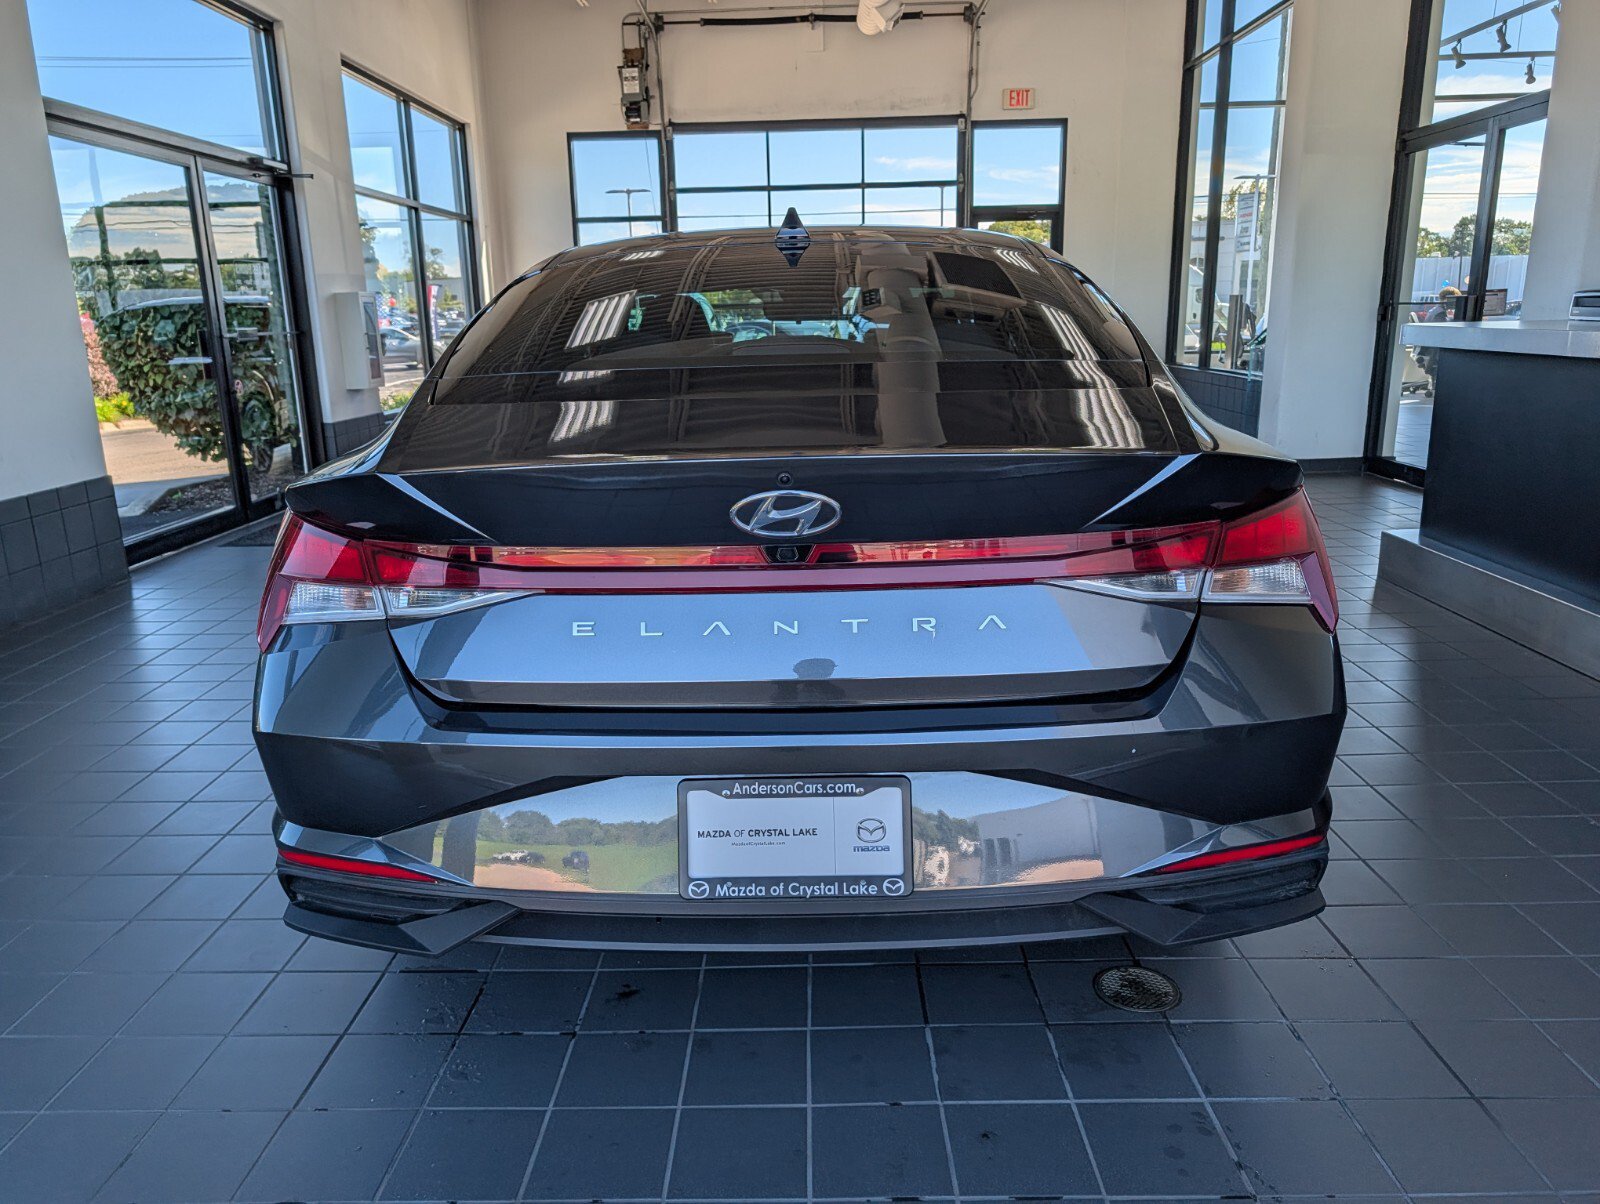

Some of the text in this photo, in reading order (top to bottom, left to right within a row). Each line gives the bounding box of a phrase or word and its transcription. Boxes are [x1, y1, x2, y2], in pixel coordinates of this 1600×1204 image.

[1009, 89, 1030, 107] EXIT
[572, 615, 1007, 636] ELANTRA
[732, 782, 856, 795] AndersonCars.com
[697, 828, 818, 839] MAZDA OF CRYSTAL LAKE
[715, 881, 878, 898] Mazda of Crystal Lake
